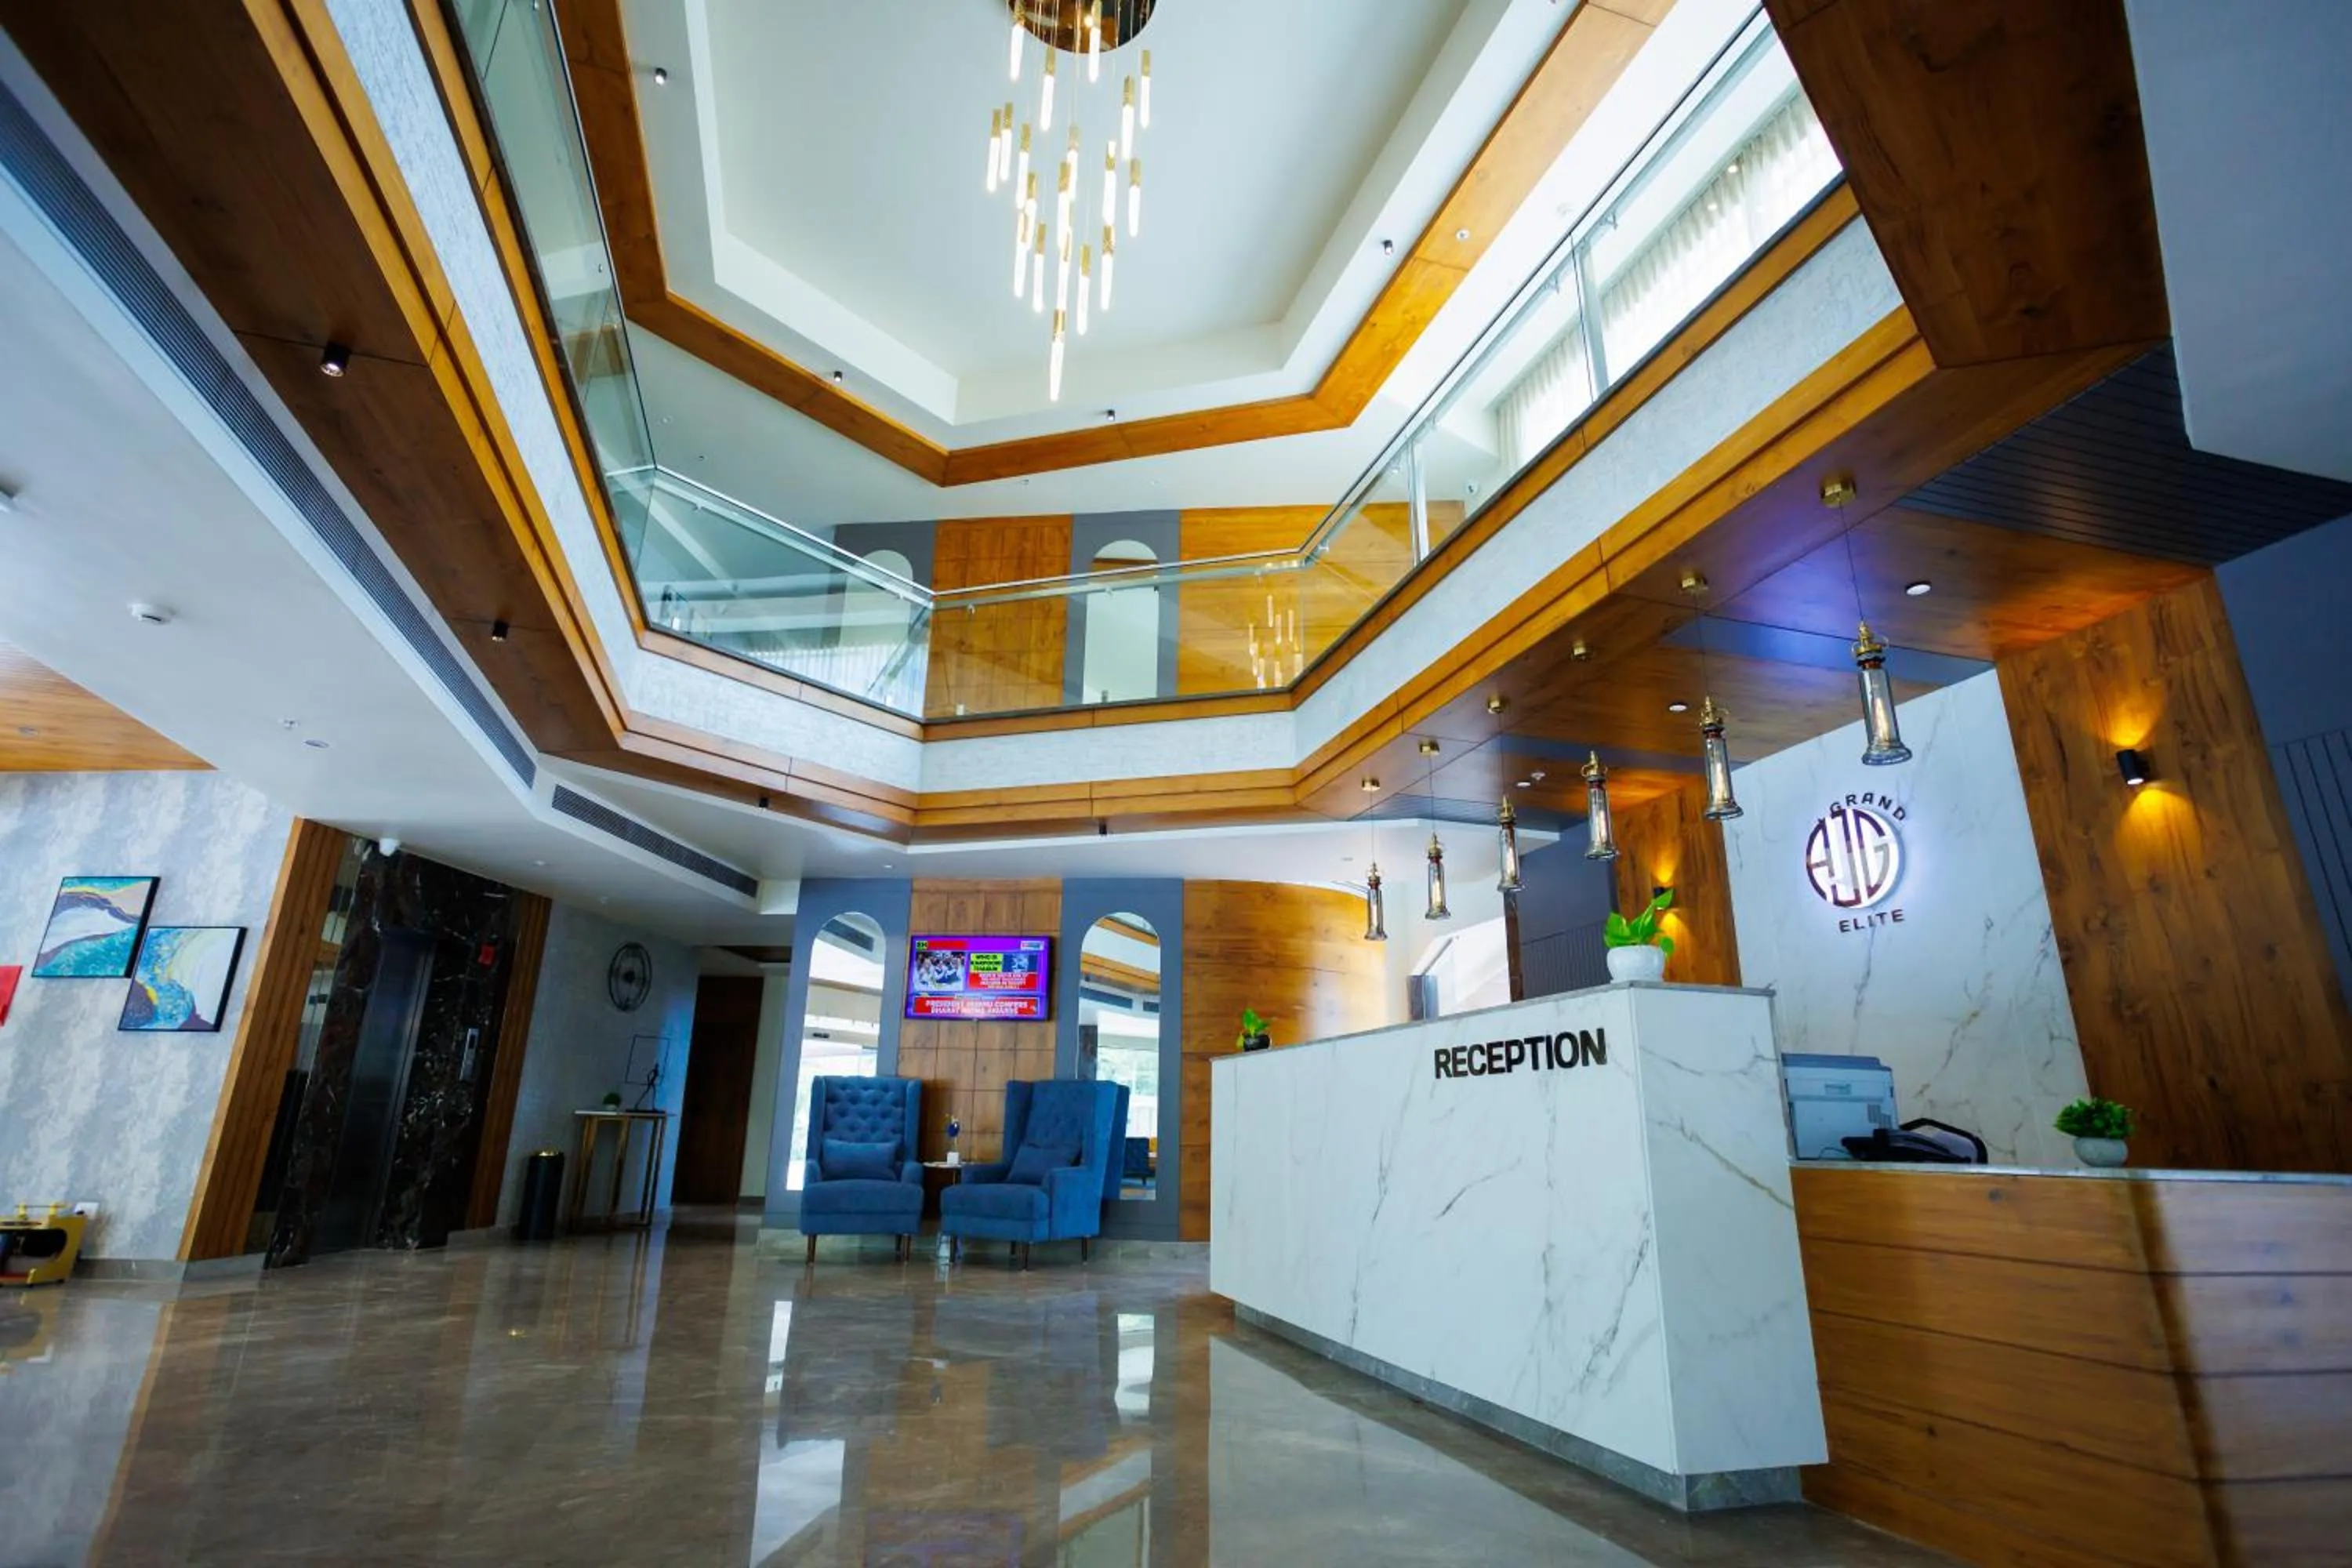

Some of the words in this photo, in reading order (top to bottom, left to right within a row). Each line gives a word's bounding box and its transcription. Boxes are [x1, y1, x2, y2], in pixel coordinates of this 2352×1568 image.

[1829, 793, 1907, 821] GRAND
[1838, 909, 1905, 934] ELITE
[1434, 1028, 1608, 1080] RECEPTION
